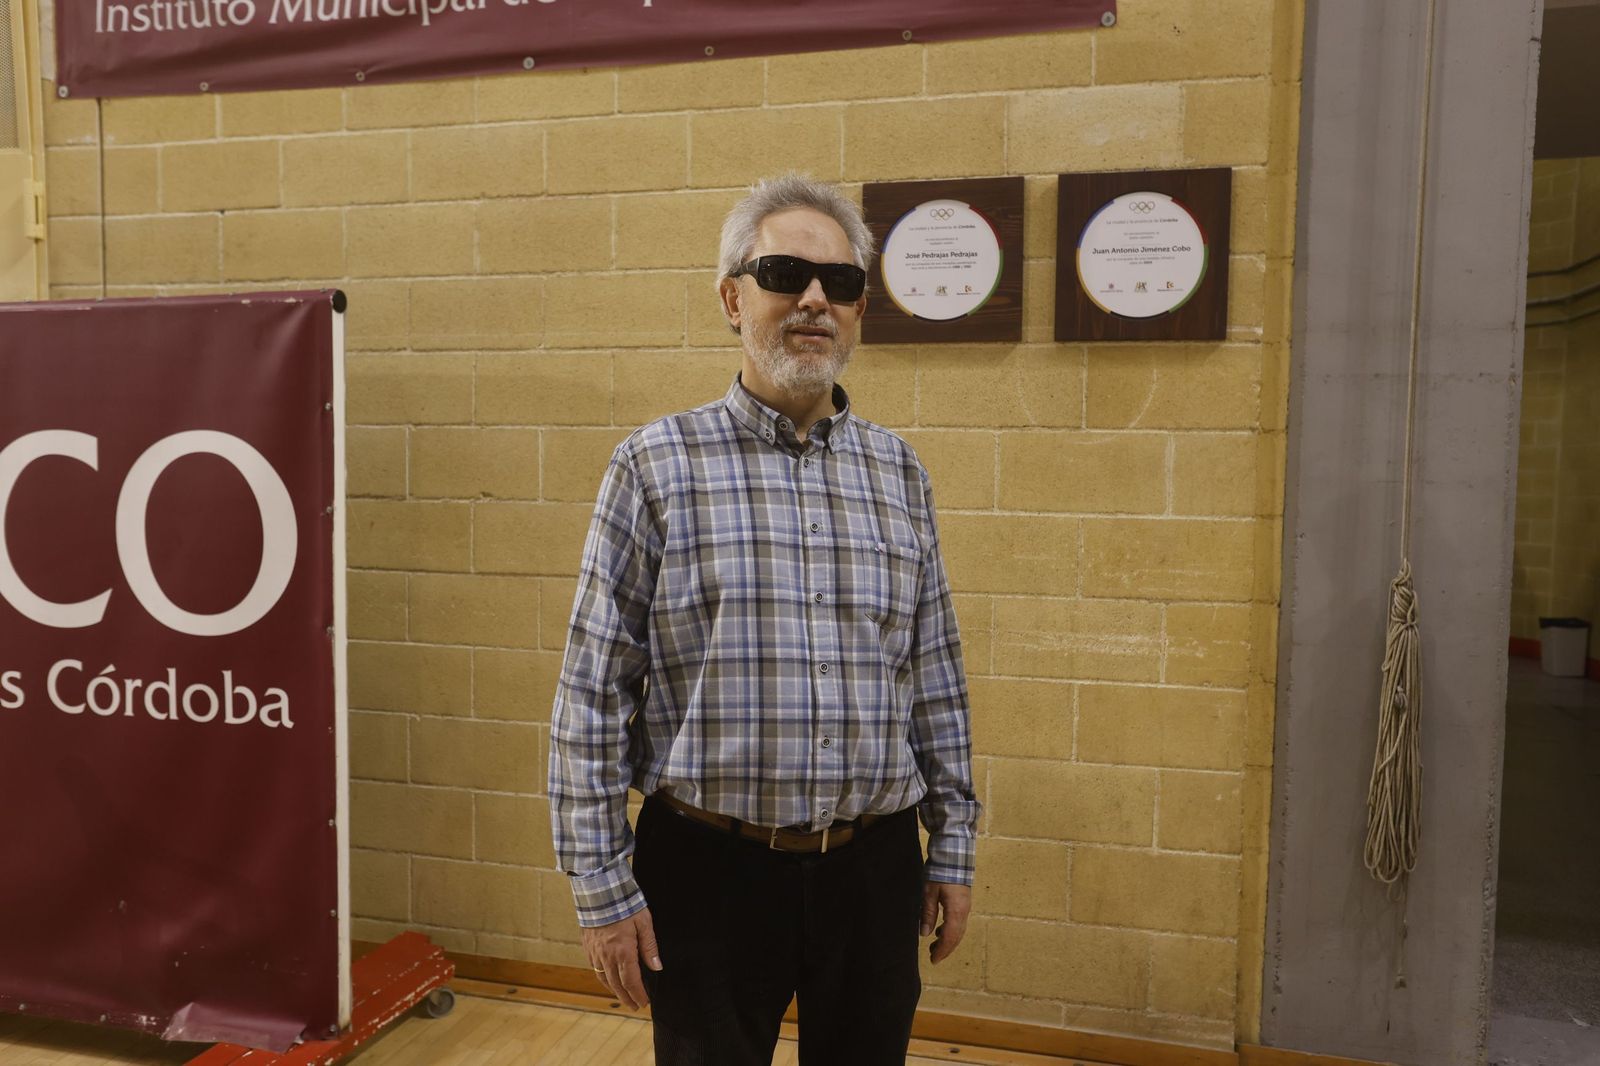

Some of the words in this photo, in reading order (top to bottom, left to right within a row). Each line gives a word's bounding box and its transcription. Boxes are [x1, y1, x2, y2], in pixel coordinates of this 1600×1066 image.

[95, 0, 256, 33] Instituto
[922, 252, 949, 260] Pedrajas
[951, 251, 978, 259] Pedrajas
[46, 658, 295, 729] Córdoba
